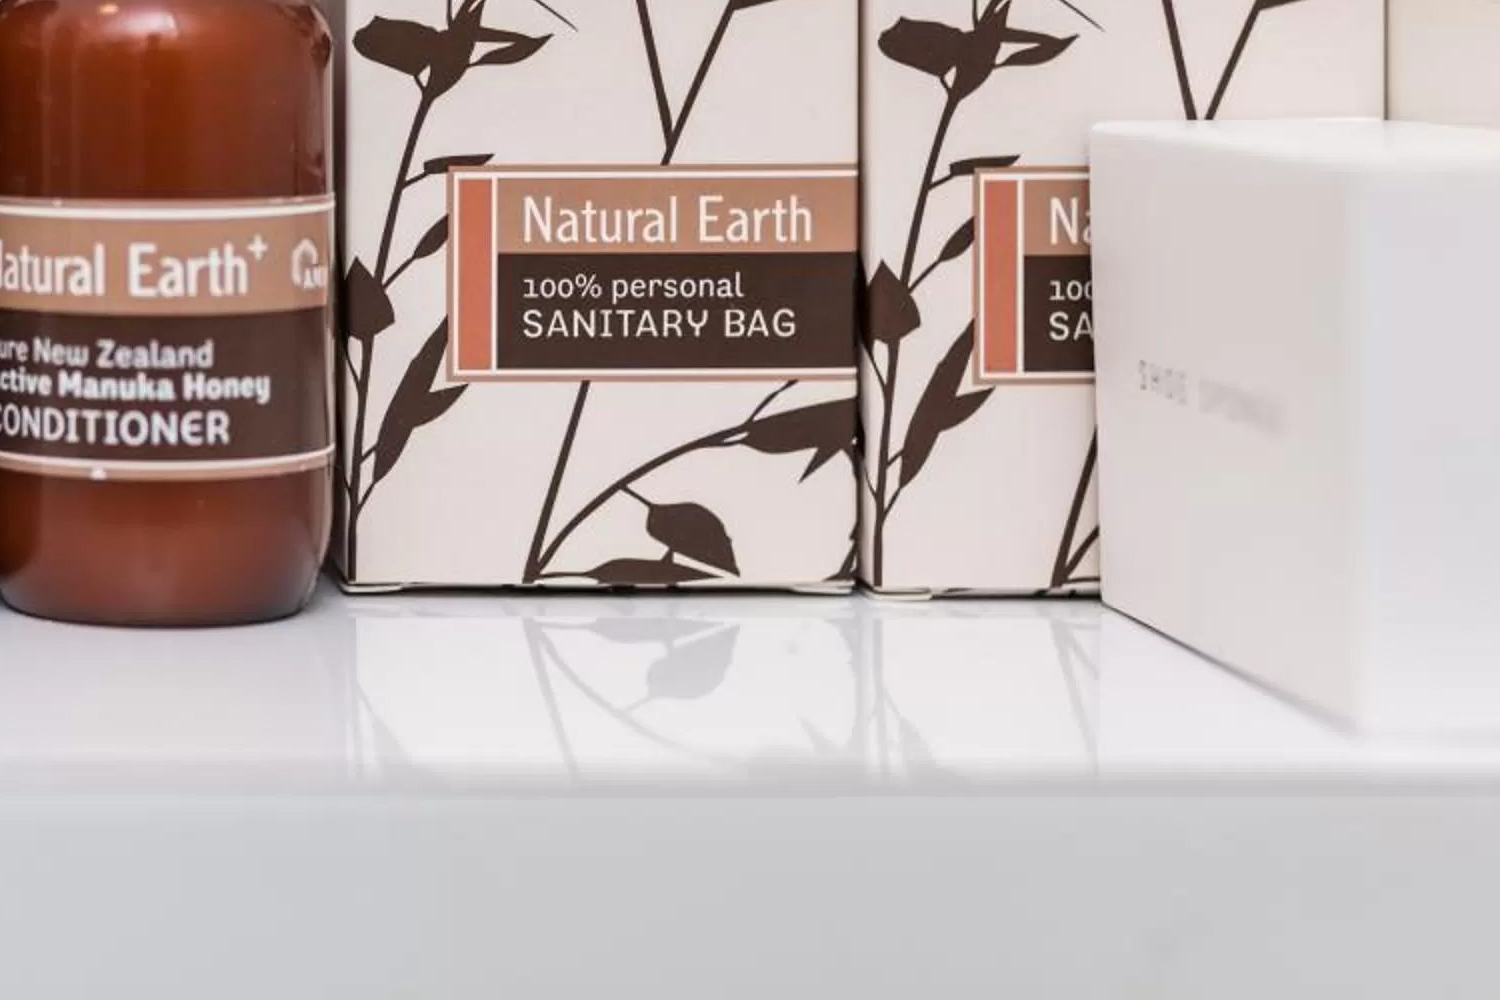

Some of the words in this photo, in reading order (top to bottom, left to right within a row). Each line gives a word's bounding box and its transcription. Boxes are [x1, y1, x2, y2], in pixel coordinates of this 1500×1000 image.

[522, 194, 679, 244] Natural
[698, 194, 813, 243] Earth
[522, 272, 604, 299] 100%
[611, 270, 745, 305] personal
[522, 308, 709, 339] SANITARY
[723, 308, 797, 339] BAG
[32, 336, 88, 366] New
[96, 339, 214, 371] Zealand
[58, 369, 176, 402] Manuka
[182, 371, 272, 406] Honey
